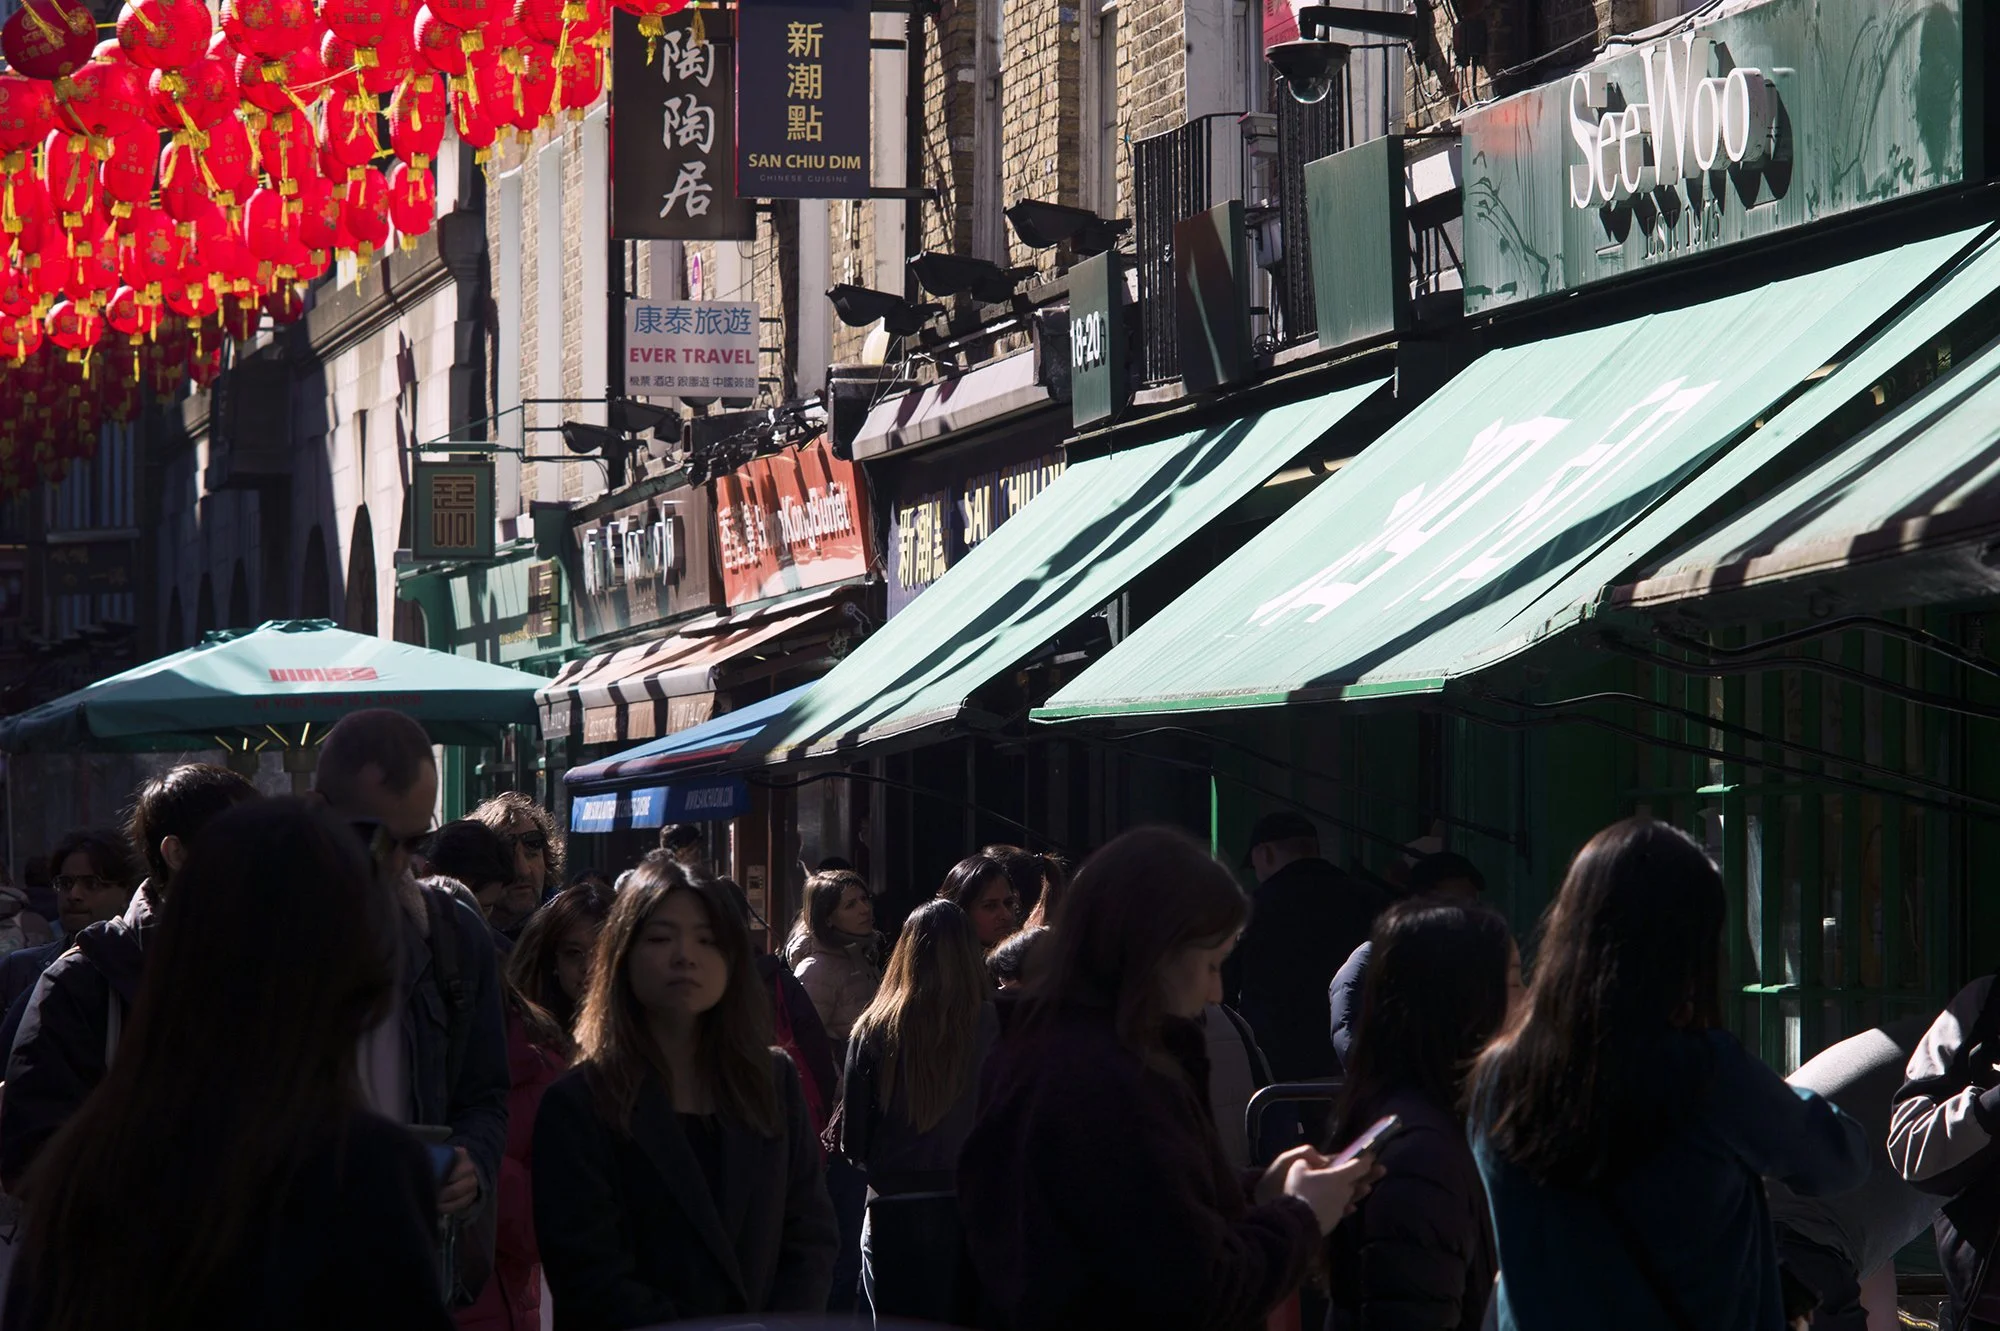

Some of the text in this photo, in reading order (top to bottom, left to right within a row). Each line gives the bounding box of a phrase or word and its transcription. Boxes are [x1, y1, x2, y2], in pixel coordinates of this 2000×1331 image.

[787, 21, 823, 142] 新潮點
[659, 27, 715, 218] 陶陶居
[748, 153, 861, 170] SAN CHIU DIM
[760, 174, 848, 183] CHINESE CUISINE
[634, 306, 752, 335] 康泰旅遊
[1070, 311, 1100, 367] 18-20
[630, 347, 755, 364] EVER TRAVEL
[653, 376, 674, 387] 酒店
